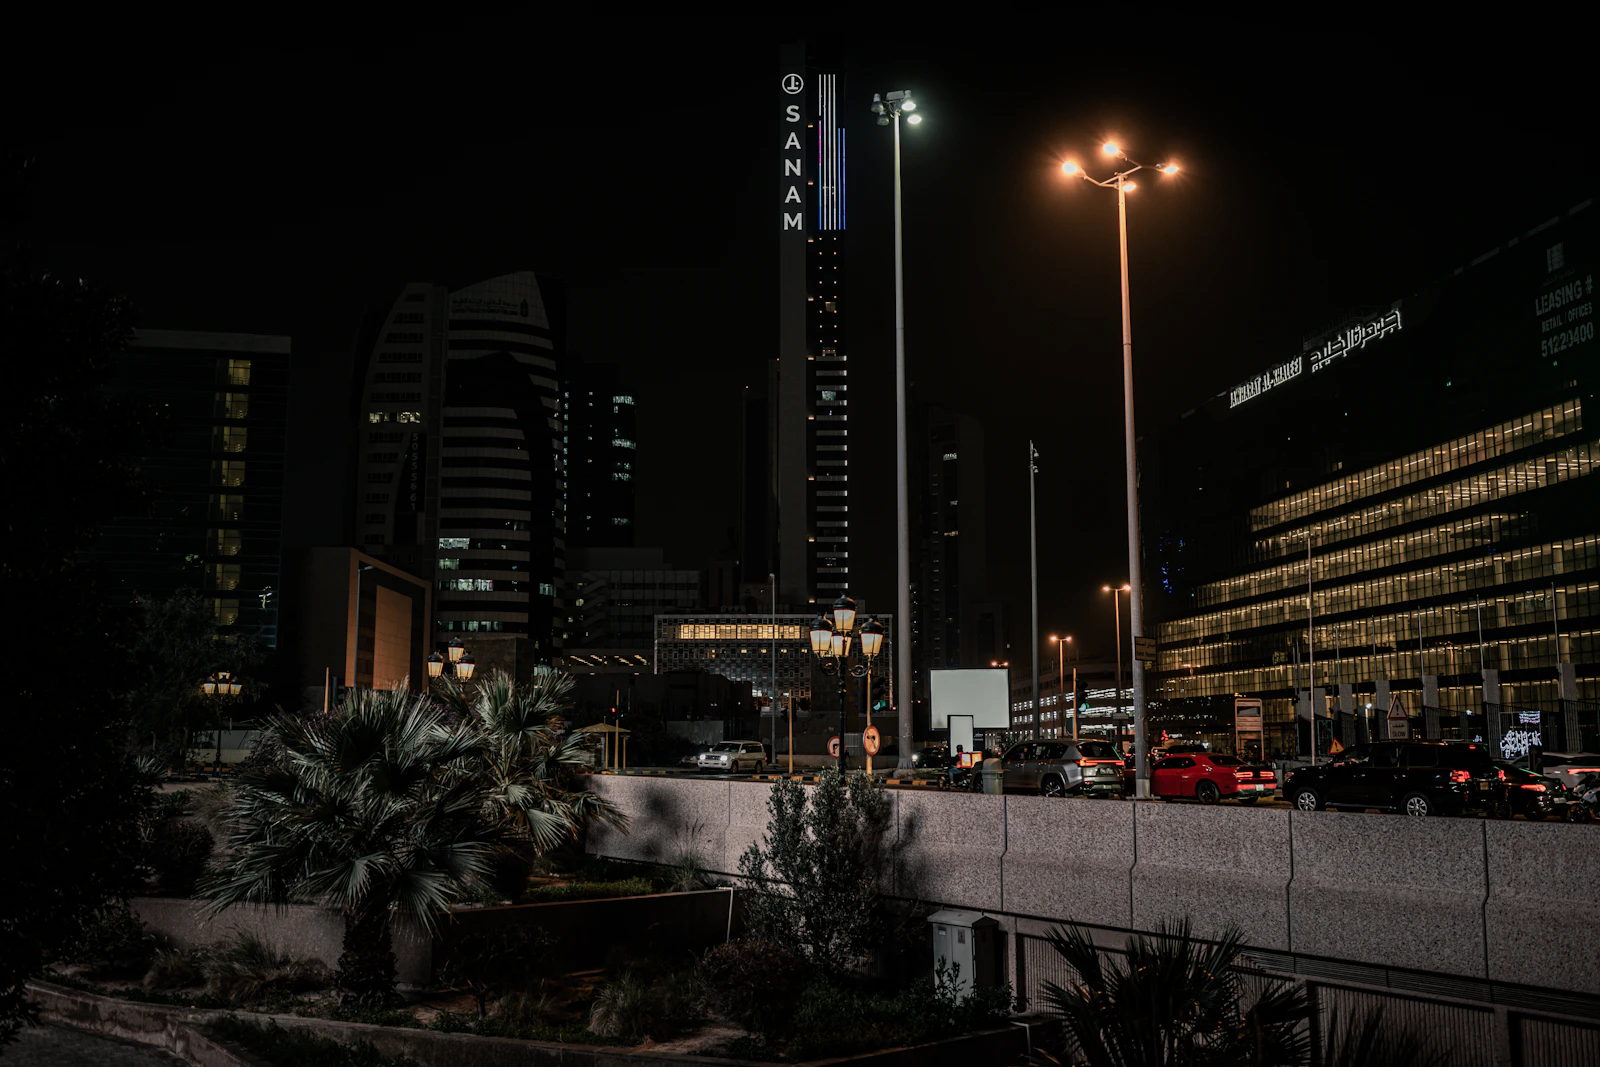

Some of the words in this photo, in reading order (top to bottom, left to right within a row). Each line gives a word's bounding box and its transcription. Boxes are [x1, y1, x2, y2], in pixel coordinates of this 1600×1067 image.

[783, 104, 803, 231] SANAM
[1535, 279, 1583, 317] LEASING
[1541, 314, 1563, 333] RETAIL
[1568, 302, 1593, 322] OFFICES
[1541, 321, 1594, 357] 51220400
